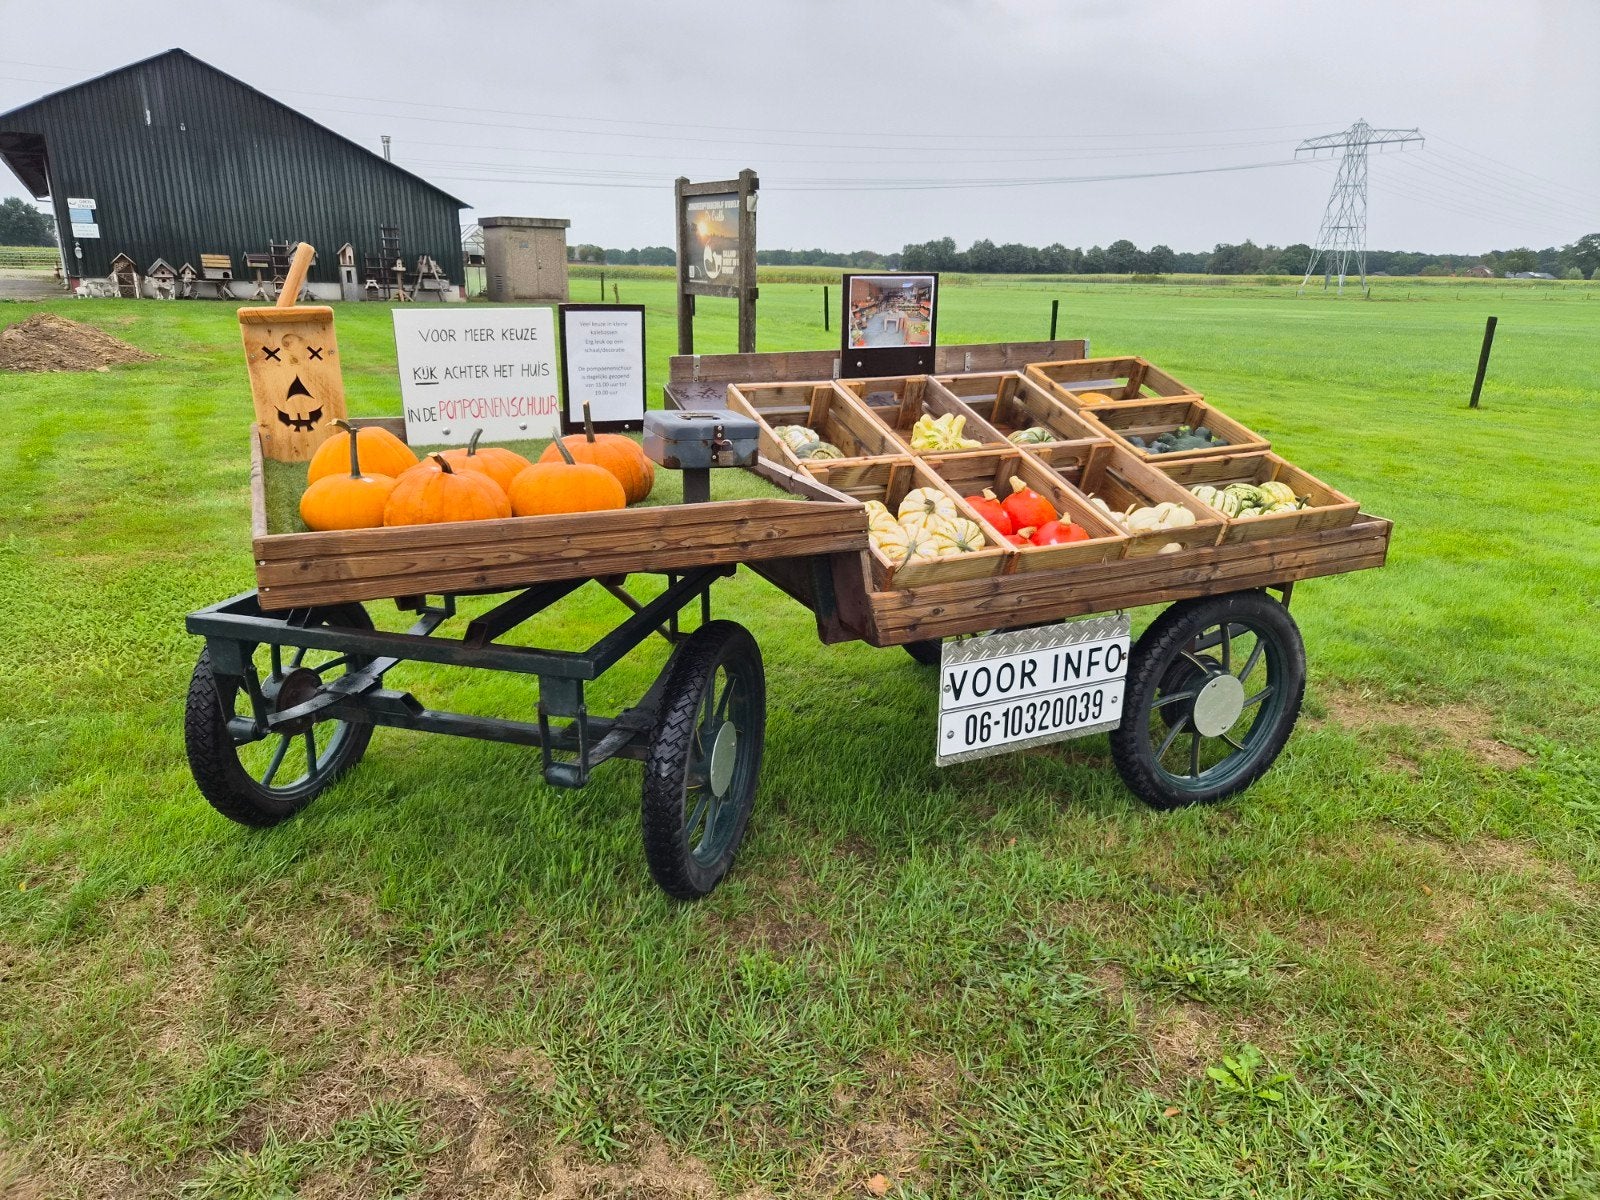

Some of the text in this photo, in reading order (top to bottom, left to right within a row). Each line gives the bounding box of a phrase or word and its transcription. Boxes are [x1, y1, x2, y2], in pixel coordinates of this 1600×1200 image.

[418, 327, 537, 342] VOOR MEER KEUZE
[444, 365, 489, 379] ACHTER
[494, 364, 514, 378] HET
[521, 361, 550, 378] HUIS
[423, 406, 437, 422] DE
[438, 394, 560, 421] POMPOENENSCHUUR
[950, 644, 1122, 701] VOOR INFO
[964, 689, 1104, 746] 06-10320039
